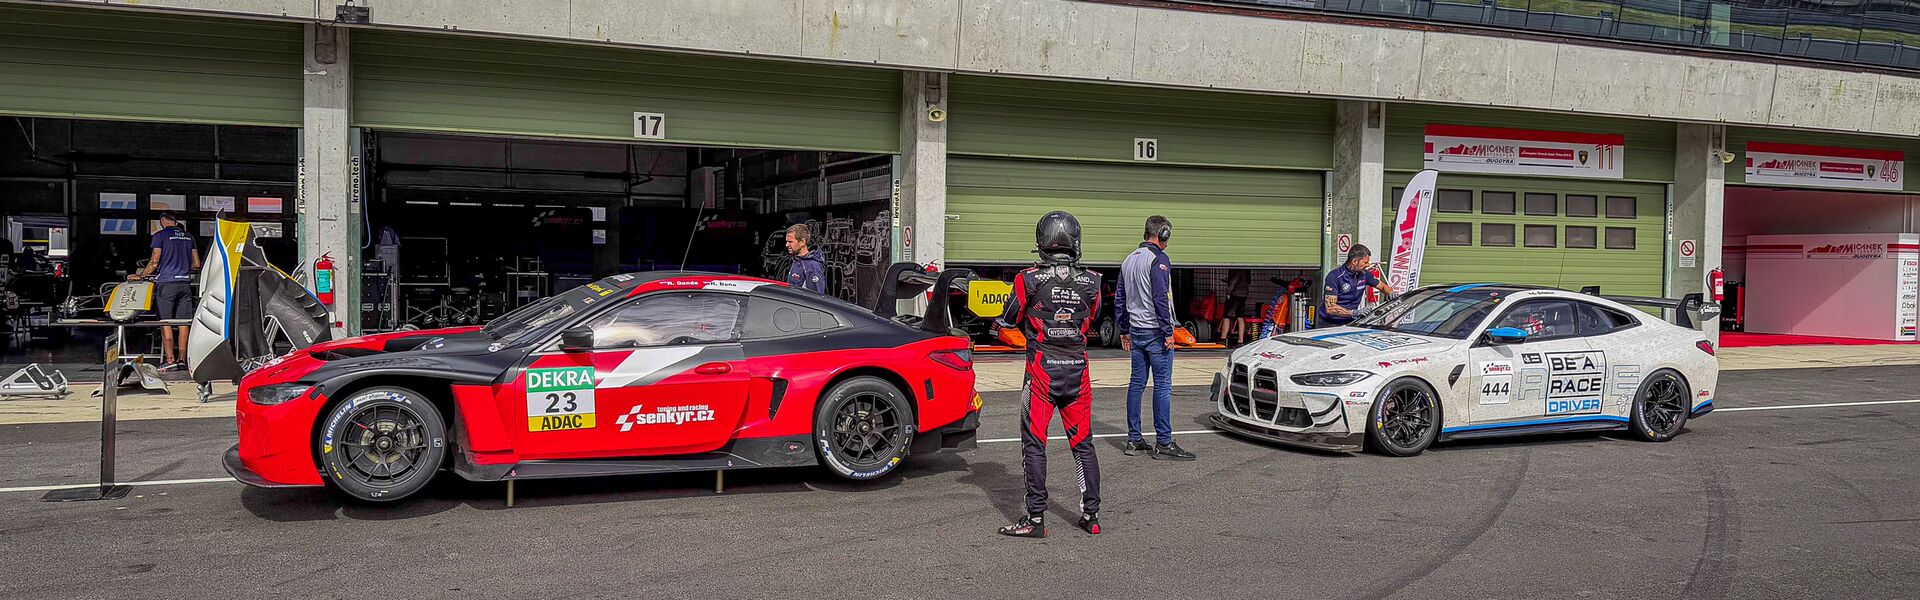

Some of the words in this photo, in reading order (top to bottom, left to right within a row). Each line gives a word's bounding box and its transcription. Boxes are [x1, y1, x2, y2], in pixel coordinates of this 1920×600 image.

[638, 115, 662, 136] 17
[1137, 141, 1155, 159] 16
[1595, 144, 1613, 170] 11
[351, 157, 359, 203] kreno.tech
[1880, 160, 1899, 182] 46
[1552, 356, 1577, 371] BE
[1582, 356, 1595, 370] A
[528, 370, 593, 389] DEKRA
[1482, 381, 1510, 396] 444
[1550, 377, 1602, 393] RACE
[545, 392, 578, 414] 23
[657, 405, 676, 413] tuning
[1549, 399, 1600, 413] DRIVER
[326, 403, 352, 439] MICHELIN
[541, 415, 583, 430] ADAC
[636, 410, 715, 426] senkyr.cz
